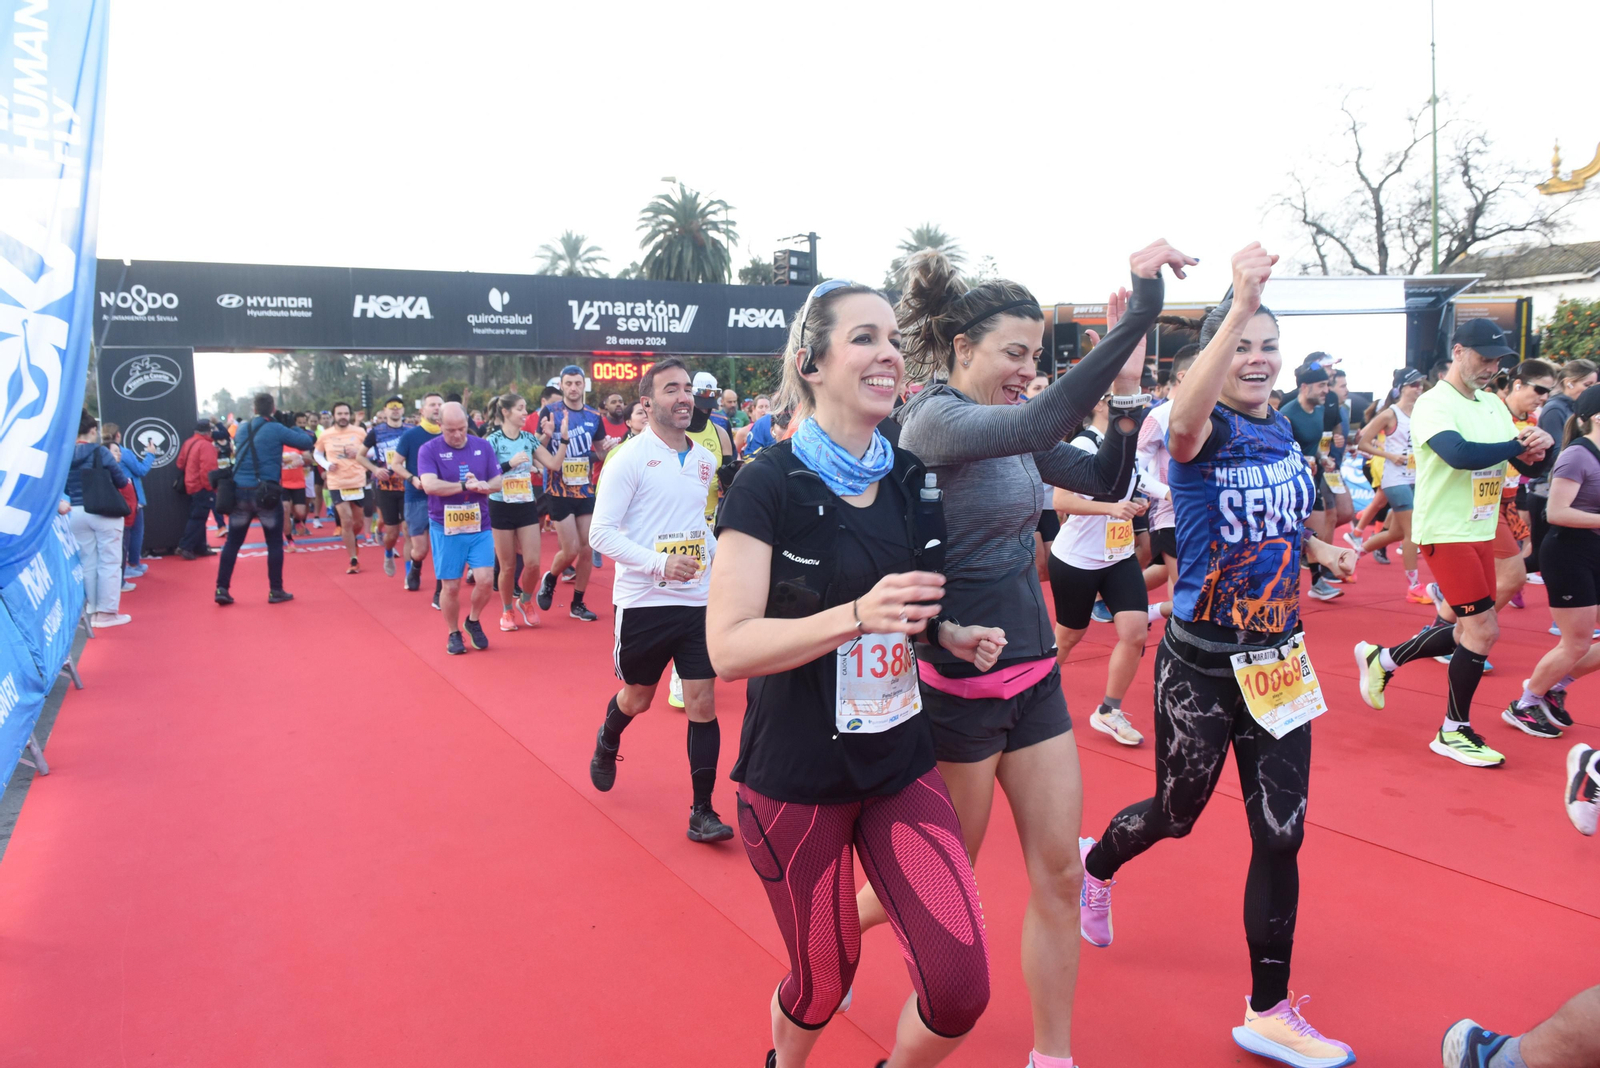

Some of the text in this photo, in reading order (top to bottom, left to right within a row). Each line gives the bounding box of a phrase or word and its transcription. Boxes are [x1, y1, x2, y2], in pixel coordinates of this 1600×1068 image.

[247, 296, 312, 308] HYUNDAI
[353, 294, 432, 319] HOKA
[594, 300, 680, 318] maratón
[247, 308, 312, 318] Hyundauto Motor
[728, 307, 786, 328] HOKA
[473, 327, 527, 336] Healthcare Partner
[617, 315, 682, 333] sevilla
[606, 336, 667, 346] 28 enero 2024
[1215, 465, 1263, 488] MEDIO
[1479, 481, 1500, 497] 9702
[447, 511, 475, 522] 10098
[1110, 524, 1133, 540] 128
[782, 550, 820, 566] SALOMON
[1252, 650, 1276, 662] MARATÓN
[1244, 655, 1302, 700] 10069
